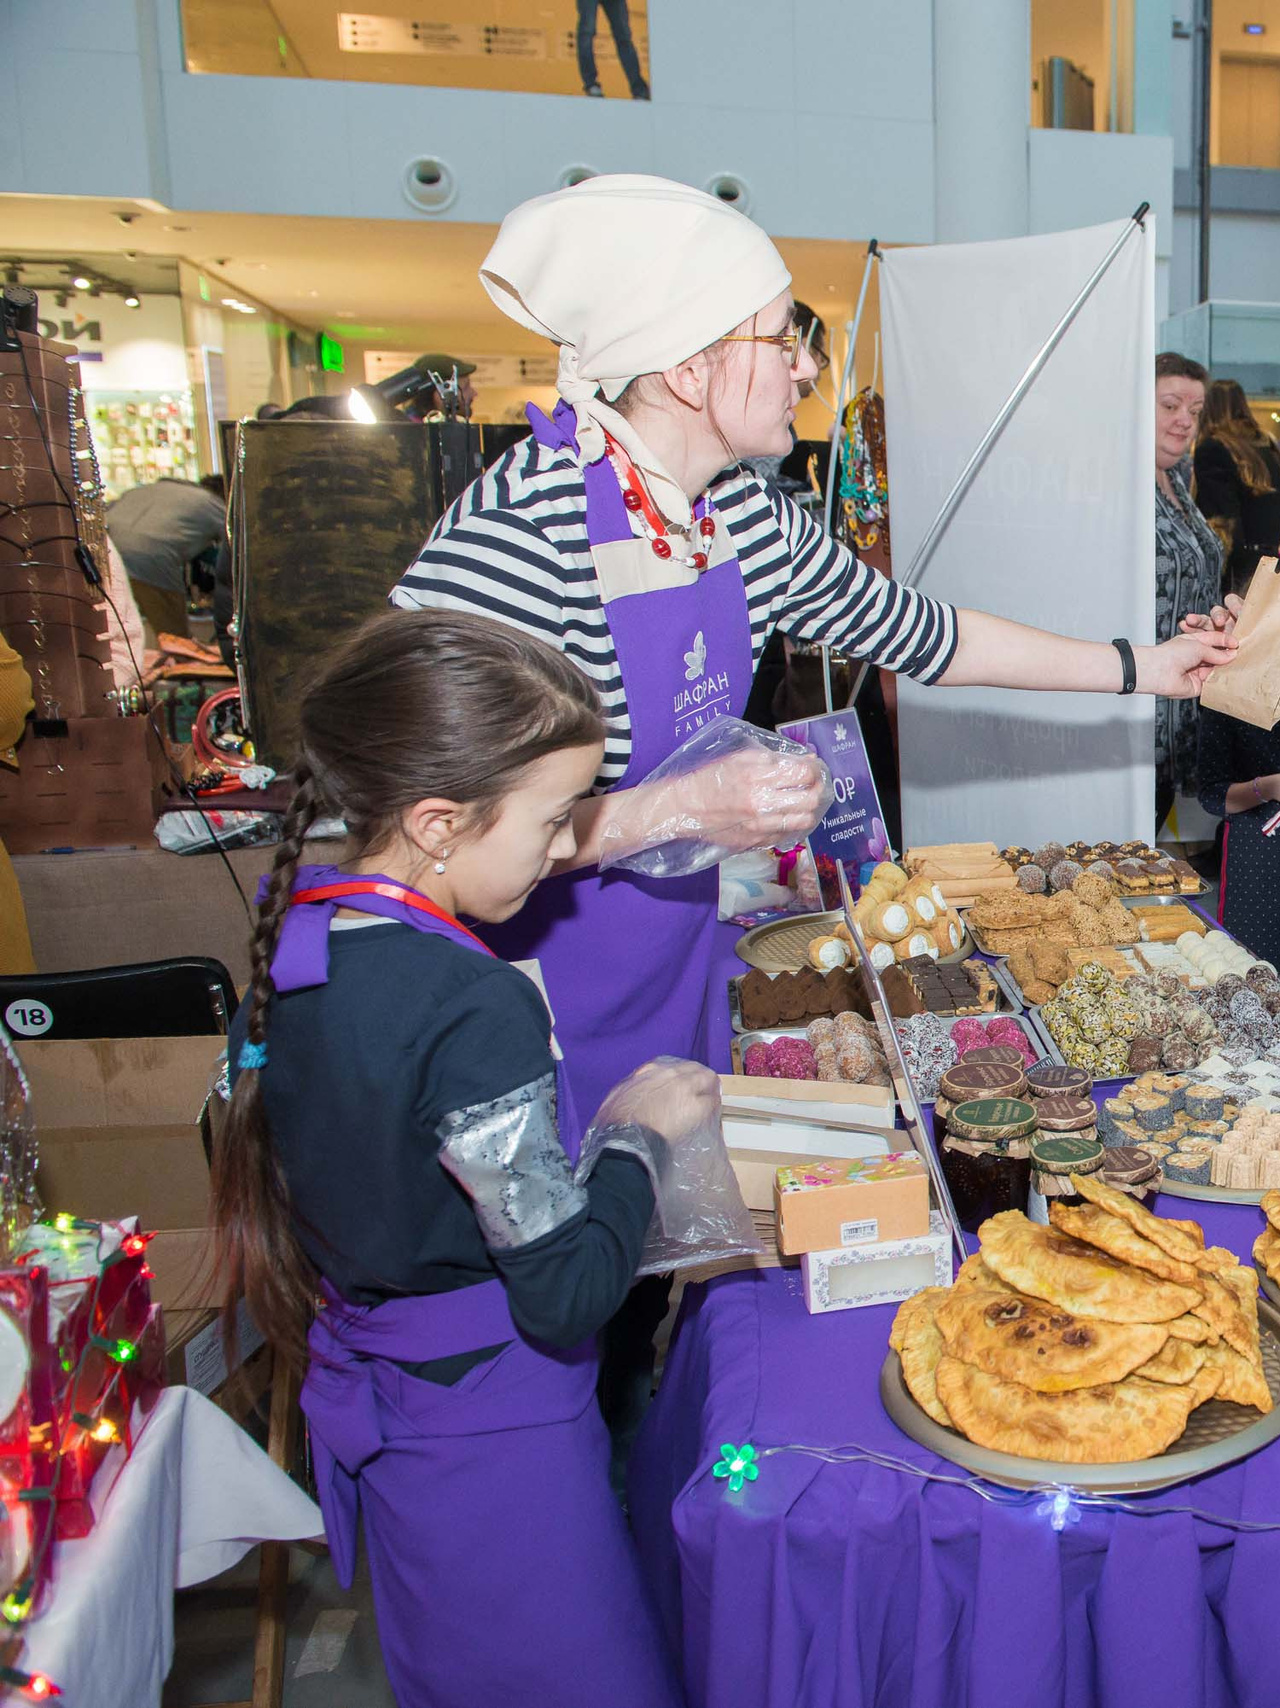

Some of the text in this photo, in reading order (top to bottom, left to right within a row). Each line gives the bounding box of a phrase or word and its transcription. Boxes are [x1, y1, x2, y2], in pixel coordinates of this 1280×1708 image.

[673, 671, 730, 713] ШАФРАН
[675, 700, 731, 738] FAMILY
[831, 740, 857, 753] ШАФРАН
[833, 776, 856, 804] 0₽
[821, 807, 867, 830] Уникальные
[830, 823, 865, 843] сладости
[13, 1008, 47, 1026] 18
